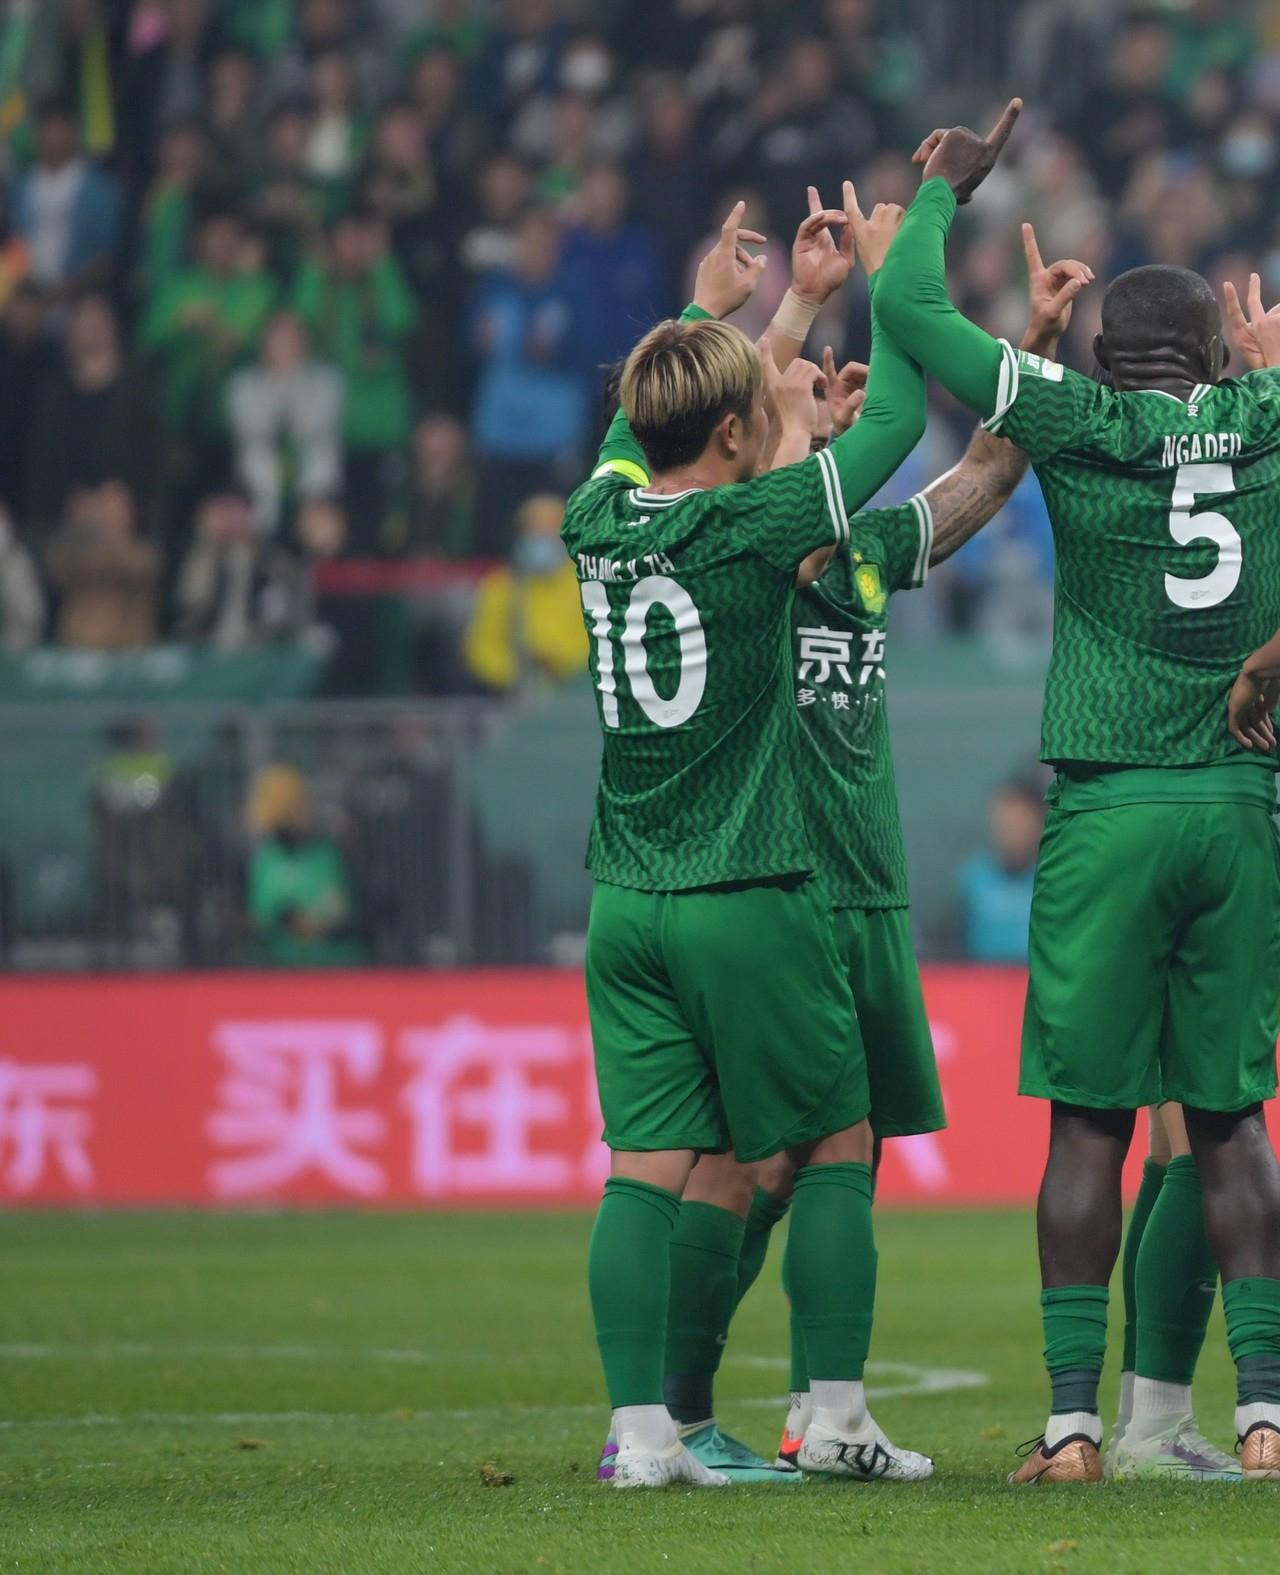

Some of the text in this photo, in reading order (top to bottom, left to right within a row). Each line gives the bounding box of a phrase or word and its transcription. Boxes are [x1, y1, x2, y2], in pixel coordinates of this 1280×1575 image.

[1164, 462, 1242, 609] 5
[581, 575, 707, 728] 10
[205, 1012, 608, 1197] 买在
